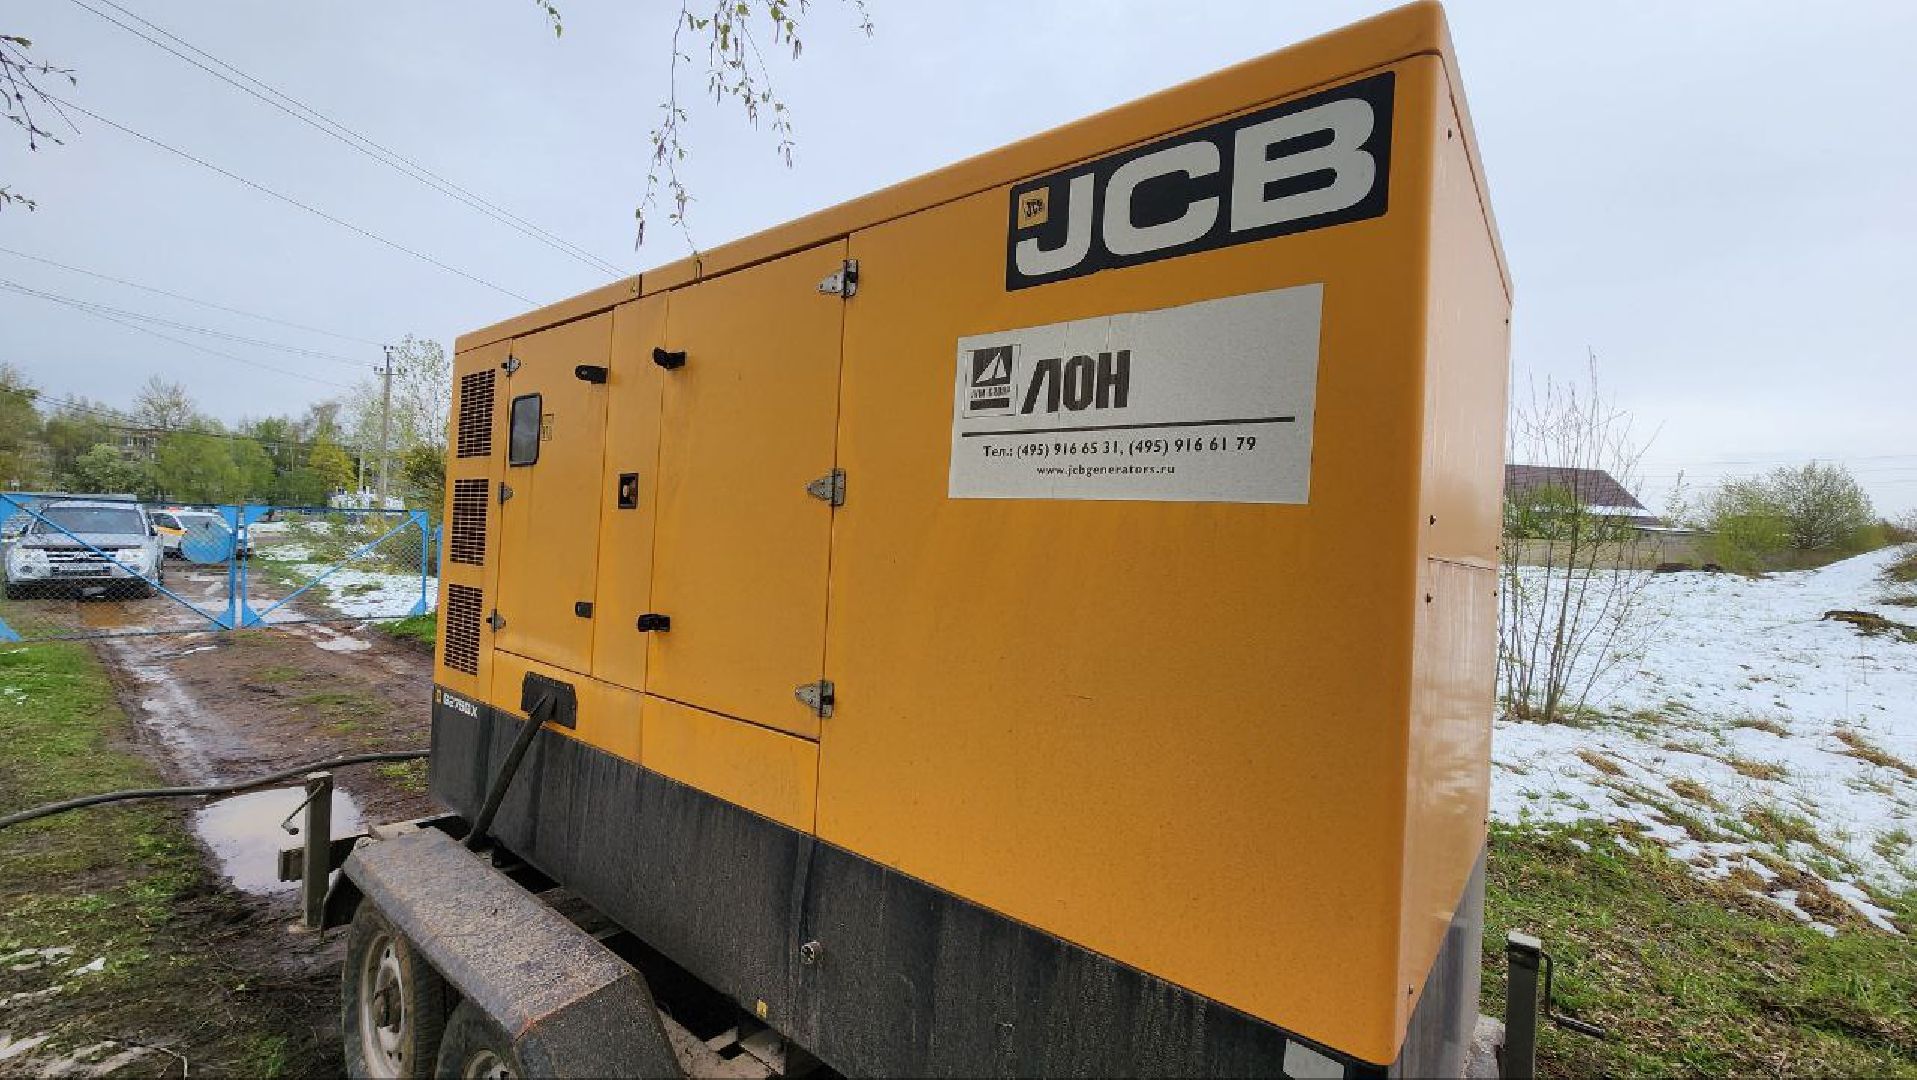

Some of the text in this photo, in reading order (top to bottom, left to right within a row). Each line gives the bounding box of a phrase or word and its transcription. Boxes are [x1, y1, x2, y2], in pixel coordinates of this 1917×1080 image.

[1015, 97, 1376, 276] JCB
[1020, 350, 1131, 415] ЛОН
[983, 436, 1256, 459] Тел.: (495) 916 65 31, (495) 916 61 79
[1036, 464, 1175, 477] www.jcbgenerators.ru
